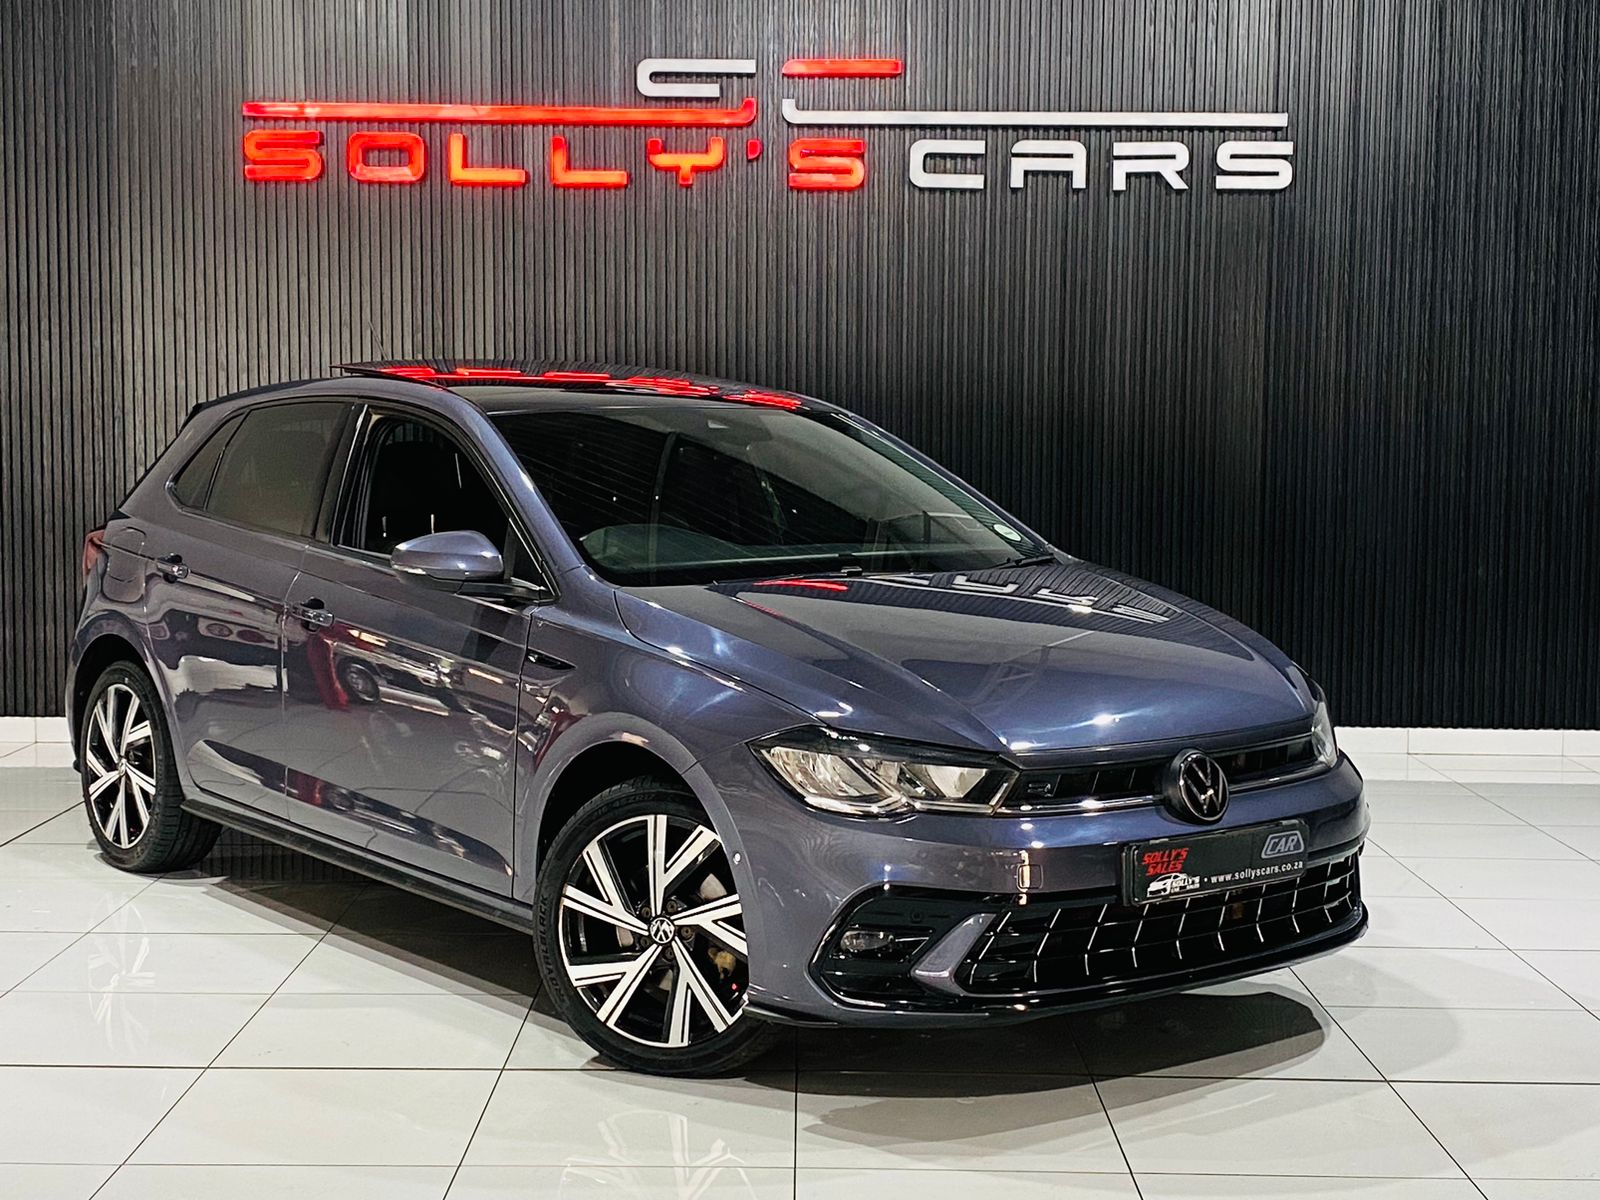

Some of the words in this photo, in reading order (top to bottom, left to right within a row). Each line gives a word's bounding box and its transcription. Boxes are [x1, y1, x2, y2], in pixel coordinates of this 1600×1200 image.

[242, 129, 866, 192] SOLLY'S
[908, 139, 1295, 192] CARS
[1267, 834, 1298, 854] CAR
[1143, 847, 1190, 865] SOLLY'S
[1146, 861, 1183, 876] SALES
[1210, 861, 1304, 884] www.sollyscars.co.za
